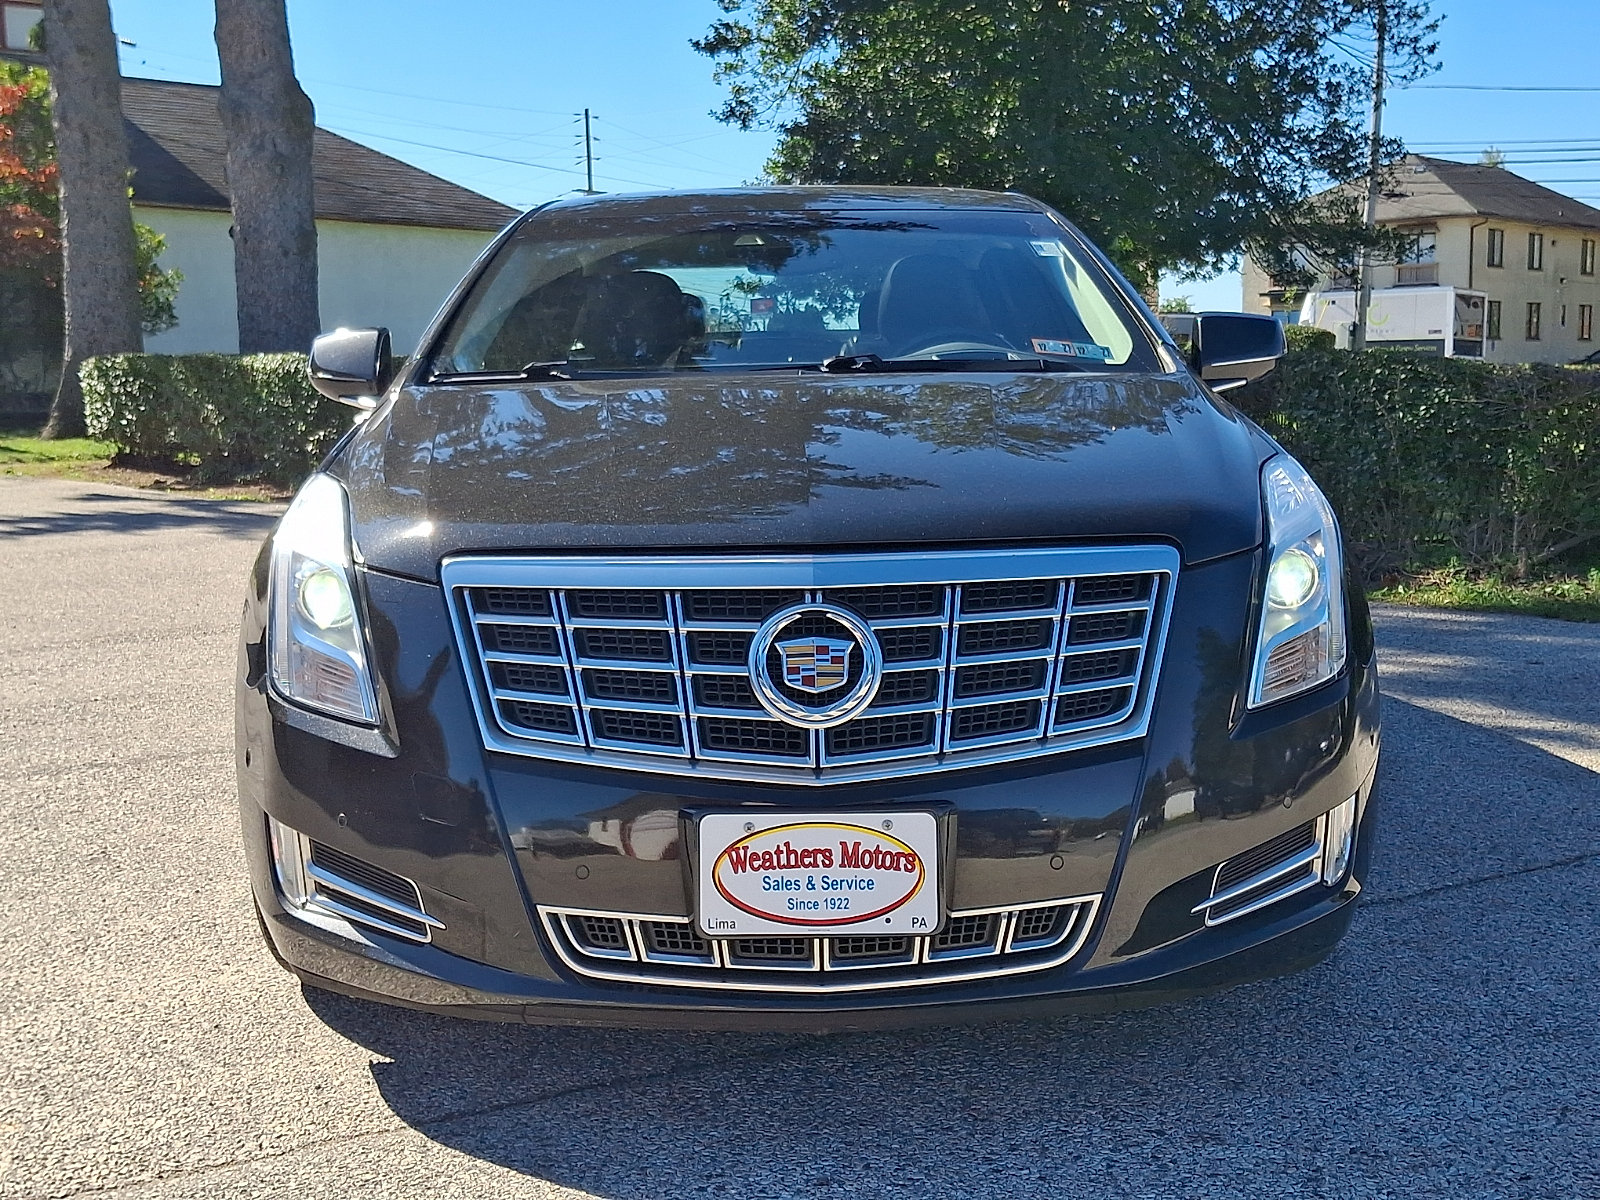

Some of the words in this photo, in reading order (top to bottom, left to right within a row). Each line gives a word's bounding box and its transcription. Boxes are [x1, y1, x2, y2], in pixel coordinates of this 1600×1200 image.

[726, 841, 833, 874] Weathers
[839, 841, 917, 873] Motors
[762, 875, 801, 892] Sales
[806, 875, 816, 891] &
[821, 875, 875, 891] Service
[787, 897, 819, 911] Since
[823, 897, 850, 911] 1922
[707, 918, 736, 930] Lima
[911, 917, 928, 929] PA
